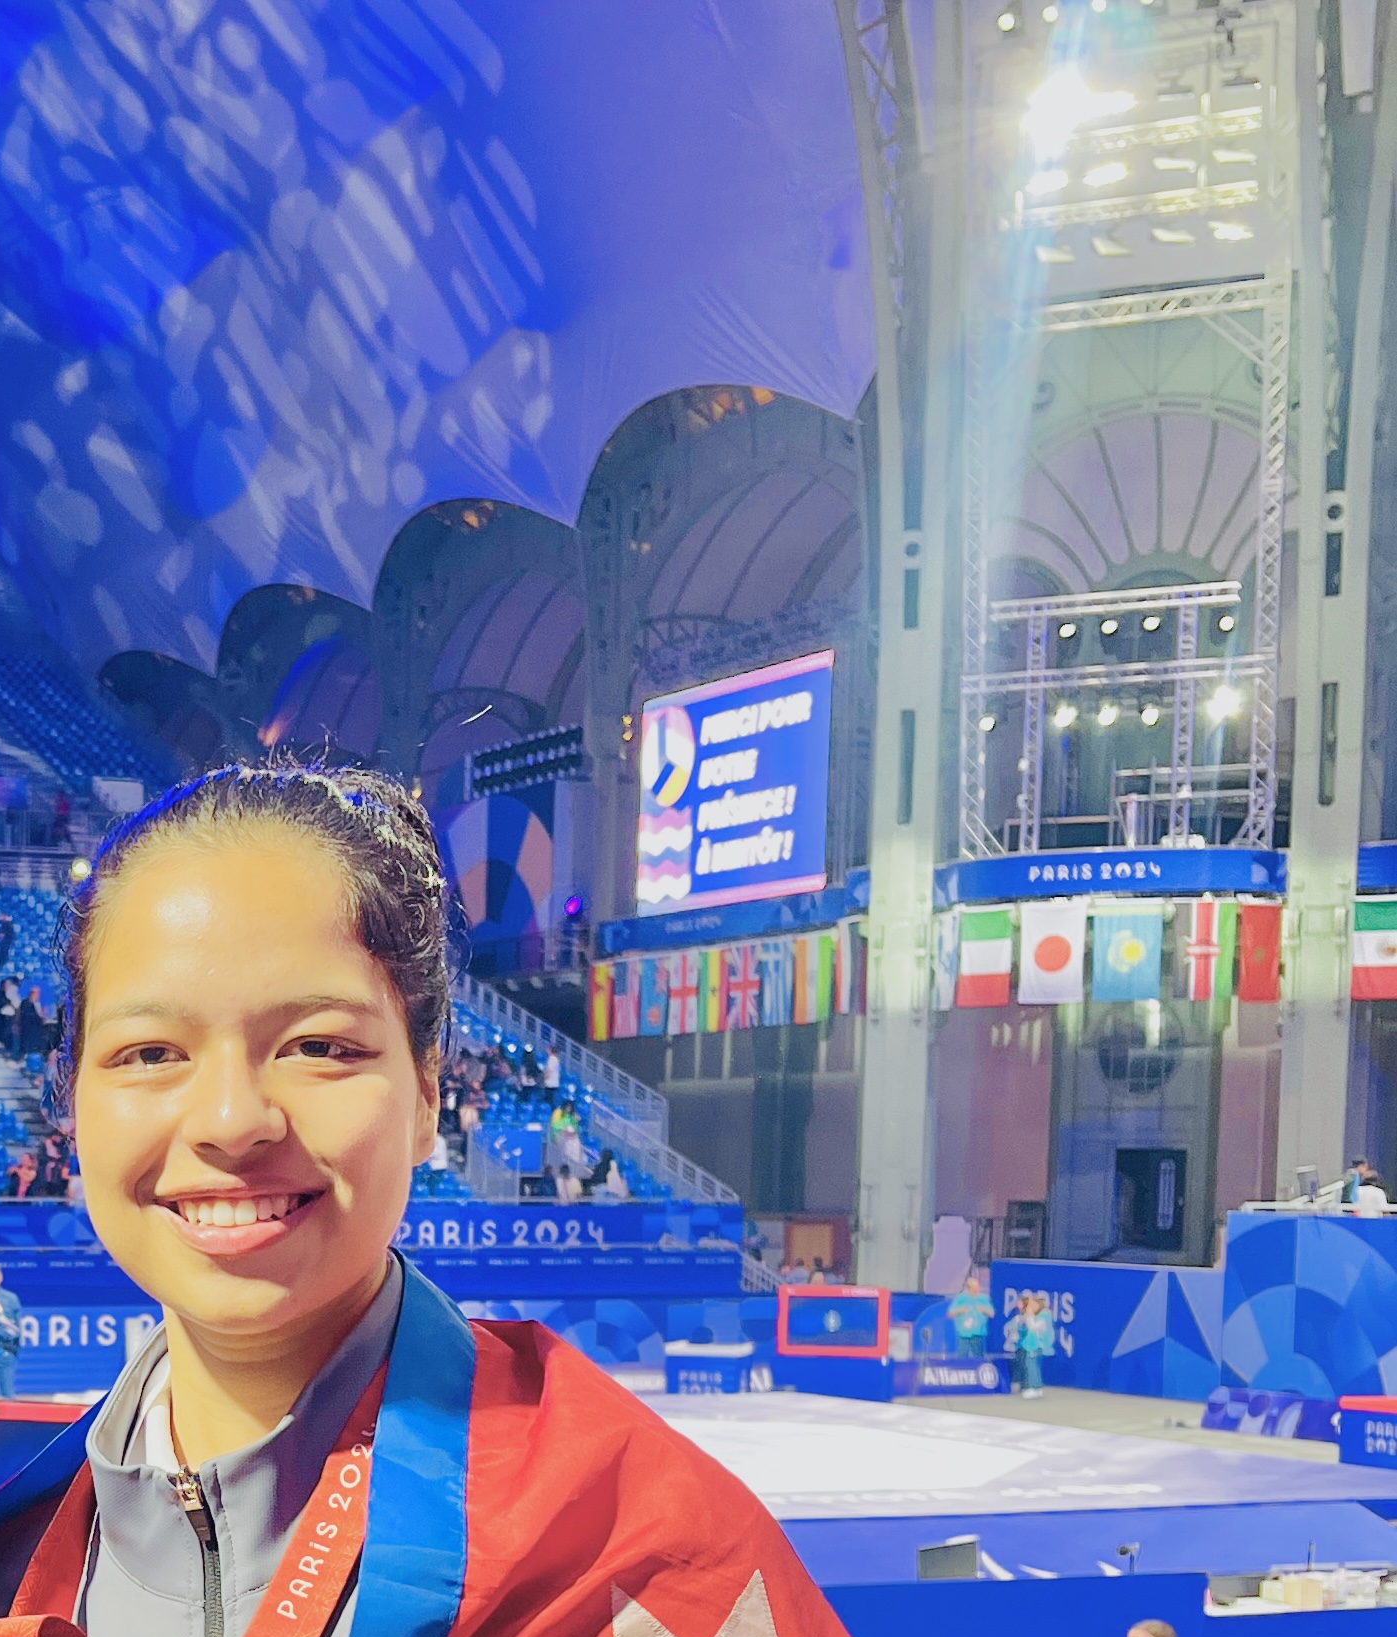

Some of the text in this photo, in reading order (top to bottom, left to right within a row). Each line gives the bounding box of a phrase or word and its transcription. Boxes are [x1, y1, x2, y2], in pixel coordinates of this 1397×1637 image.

[1028, 861, 1161, 882] PARIS 2024
[512, 1219, 605, 1248] 2024
[20, 1314, 118, 1347] ARIS
[924, 1366, 977, 1386] Allianz
[1364, 1419, 1397, 1439] PAR
[1365, 1436, 1397, 1456] 202
[276, 1521, 339, 1620] PARIS
